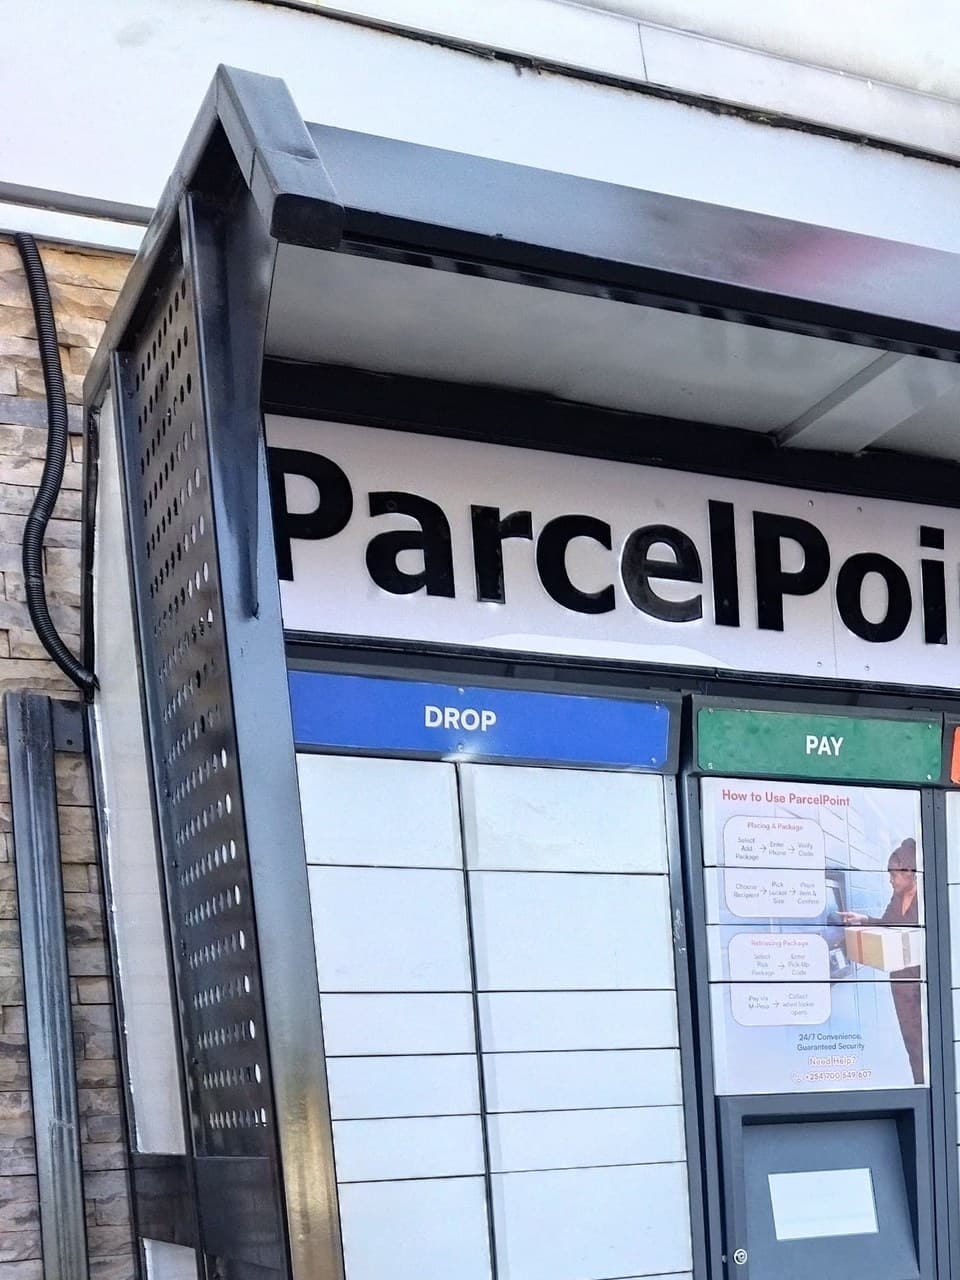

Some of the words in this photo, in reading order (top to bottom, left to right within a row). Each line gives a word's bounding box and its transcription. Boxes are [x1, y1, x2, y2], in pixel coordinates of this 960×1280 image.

[424, 705, 497, 732] DROP
[805, 735, 845, 756] PAY
[722, 789, 748, 802] How
[751, 790, 762, 802] to
[765, 791, 786, 804] Use
[789, 793, 850, 807] ParcelPoint
[777, 823, 804, 832] Package
[798, 1033, 815, 1041] 24/7
[796, 1043, 837, 1052] Guaranteed
[838, 1042, 865, 1051] Security
[809, 1055, 831, 1065] Need
